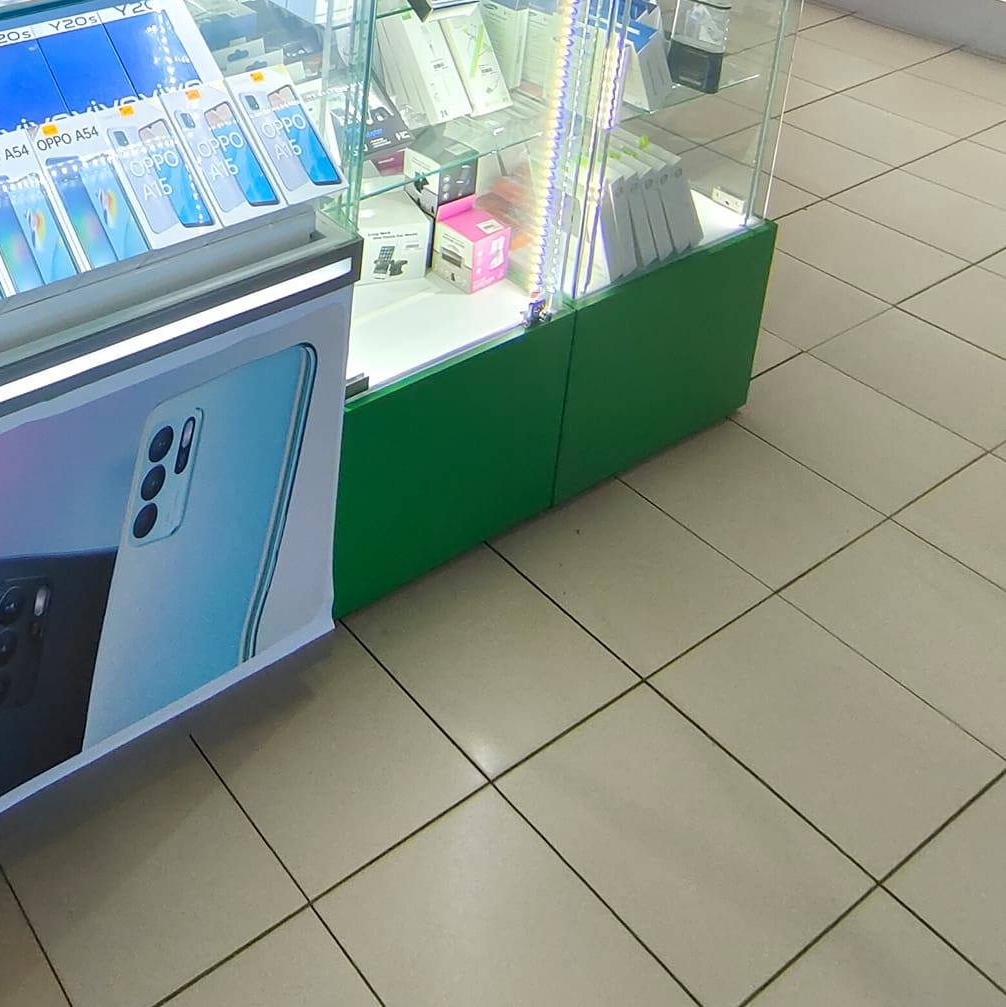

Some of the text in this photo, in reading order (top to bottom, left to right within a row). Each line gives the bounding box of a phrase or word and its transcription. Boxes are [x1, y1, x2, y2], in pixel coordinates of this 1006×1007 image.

[48, 15, 98, 32] Y20s
[261, 113, 307, 139] OPPO
[37, 125, 99, 152] OPPO A54
[197, 131, 244, 158] OPPO
[274, 138, 303, 161] A15
[4, 144, 30, 161] A54
[129, 149, 180, 177] OPPO
[209, 157, 239, 181] A15
[142, 177, 173, 201] A15
